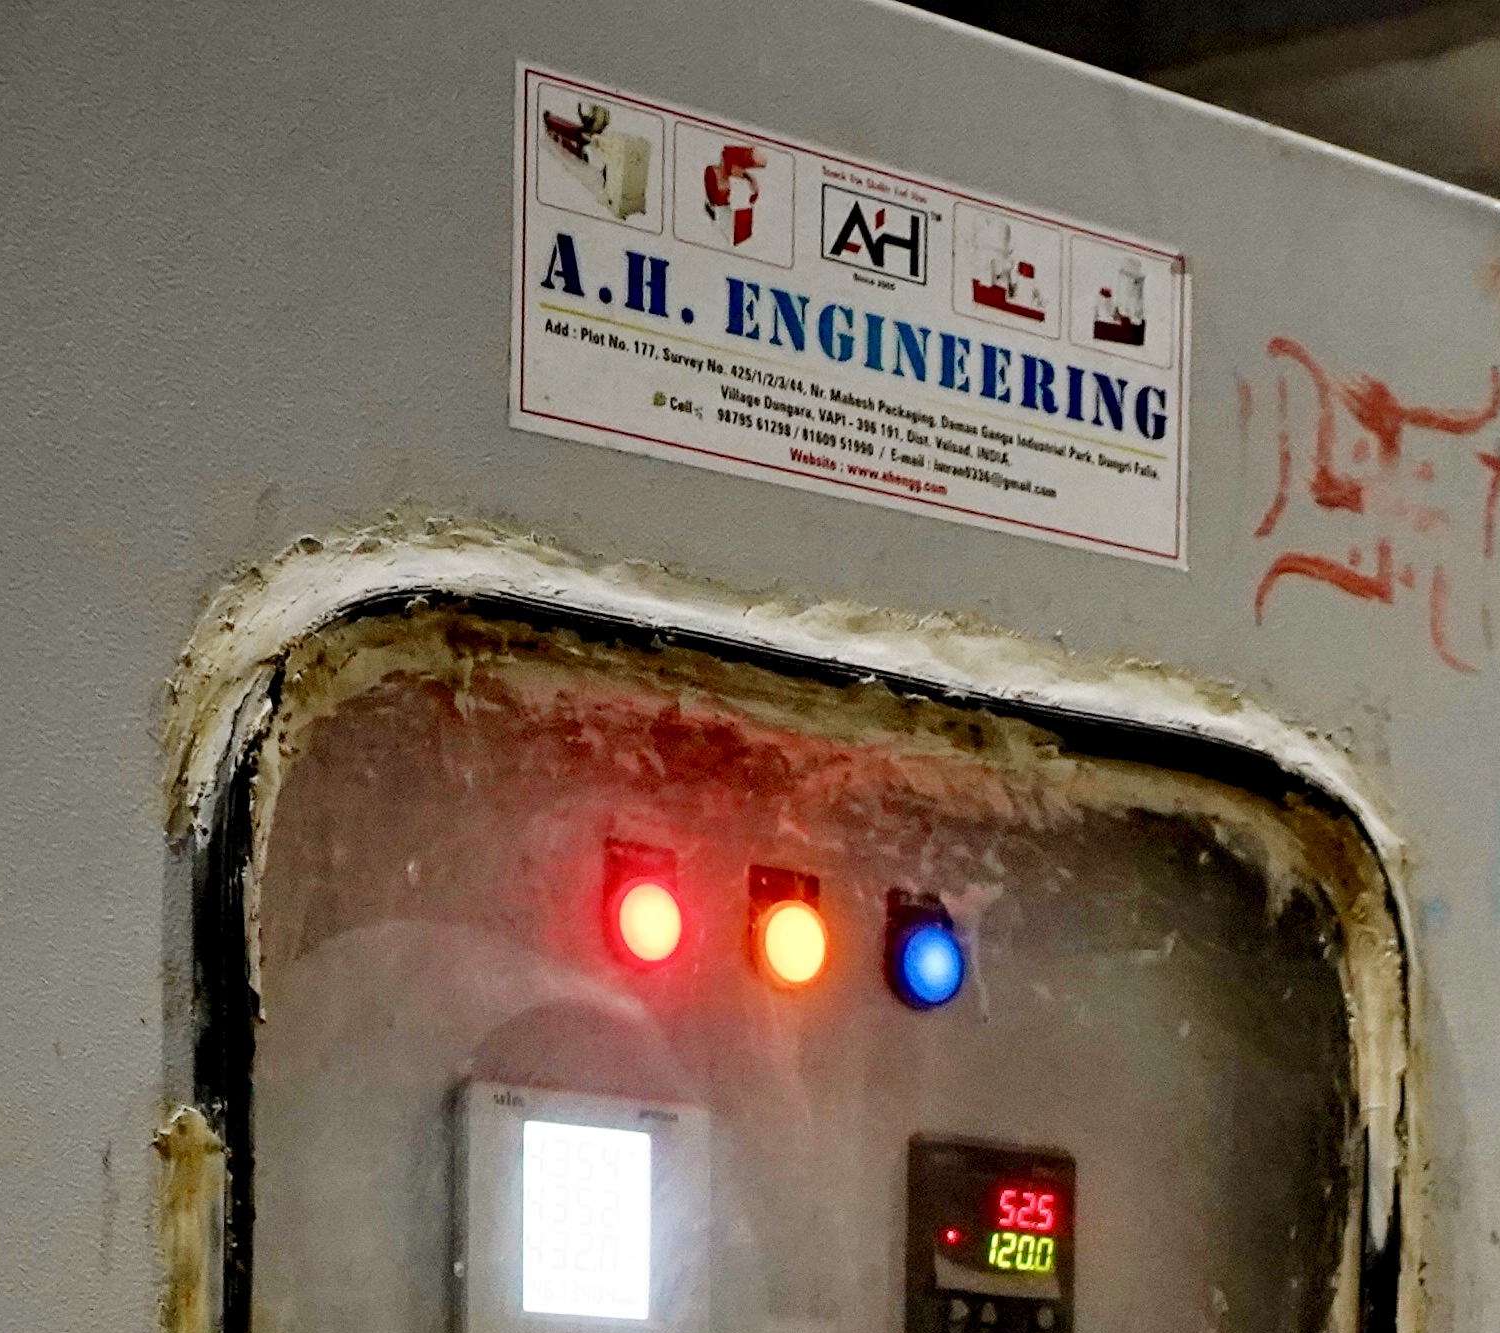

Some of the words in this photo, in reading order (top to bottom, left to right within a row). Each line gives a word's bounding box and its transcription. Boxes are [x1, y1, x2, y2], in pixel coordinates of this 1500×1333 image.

[540, 232, 694, 324] A.H.
[725, 276, 1168, 440] ENGINEERING
[545, 319, 569, 338] Add
[581, 328, 604, 346] Plot
[663, 347, 703, 373] Survey
[670, 396, 693, 414] Cell
[721, 385, 761, 408] Village
[790, 448, 836, 471] Website
